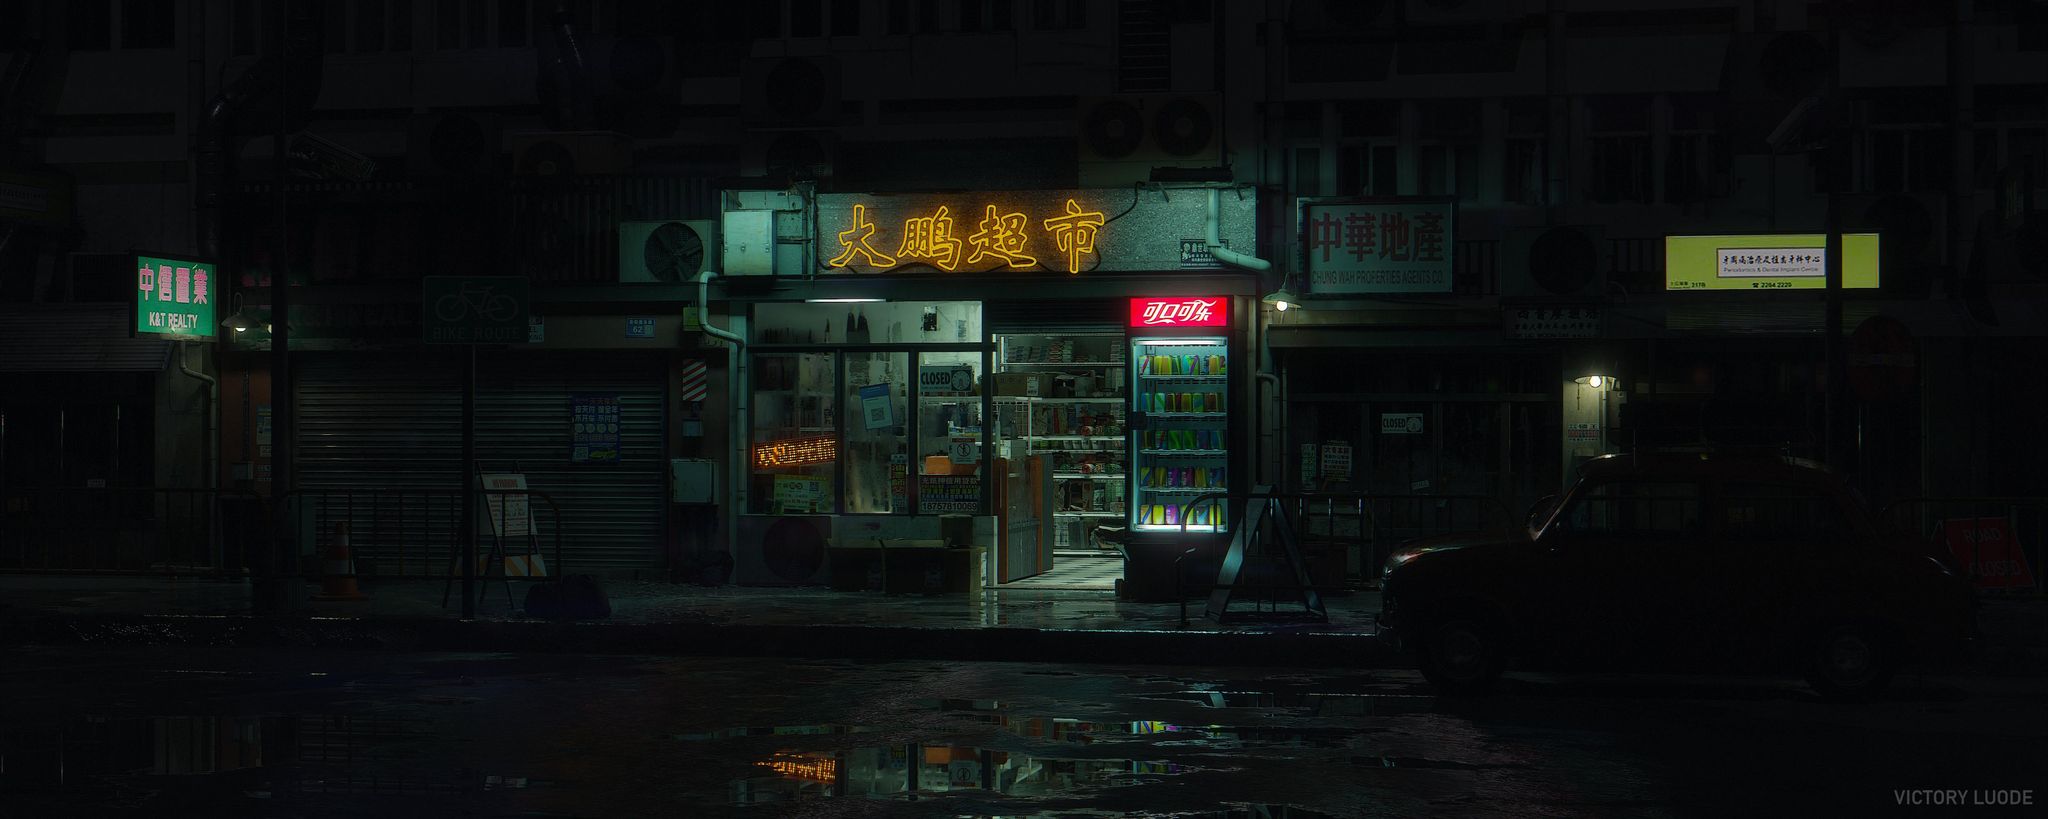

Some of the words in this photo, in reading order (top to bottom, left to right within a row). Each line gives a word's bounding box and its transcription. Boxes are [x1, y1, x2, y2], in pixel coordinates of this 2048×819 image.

[829, 199, 1105, 275] 大鹏超市
[1312, 212, 1444, 262] 中華地產
[1312, 270, 1337, 284] CHUNG
[1338, 270, 1355, 284] WAH
[1356, 270, 1401, 284] PROPERTIES
[1402, 270, 1431, 284] AGENTS
[149, 311, 165, 328] K&T
[168, 312, 198, 328] REALTY
[1143, 300, 1217, 324] 可口可乐
[433, 327, 465, 340] BIKE
[474, 327, 521, 340] ROUTE
[921, 371, 951, 385] CLOSED
[1383, 418, 1406, 428] CLOSED
[1962, 528, 2000, 544] ROAD
[1968, 559, 2022, 576] CLOSED
